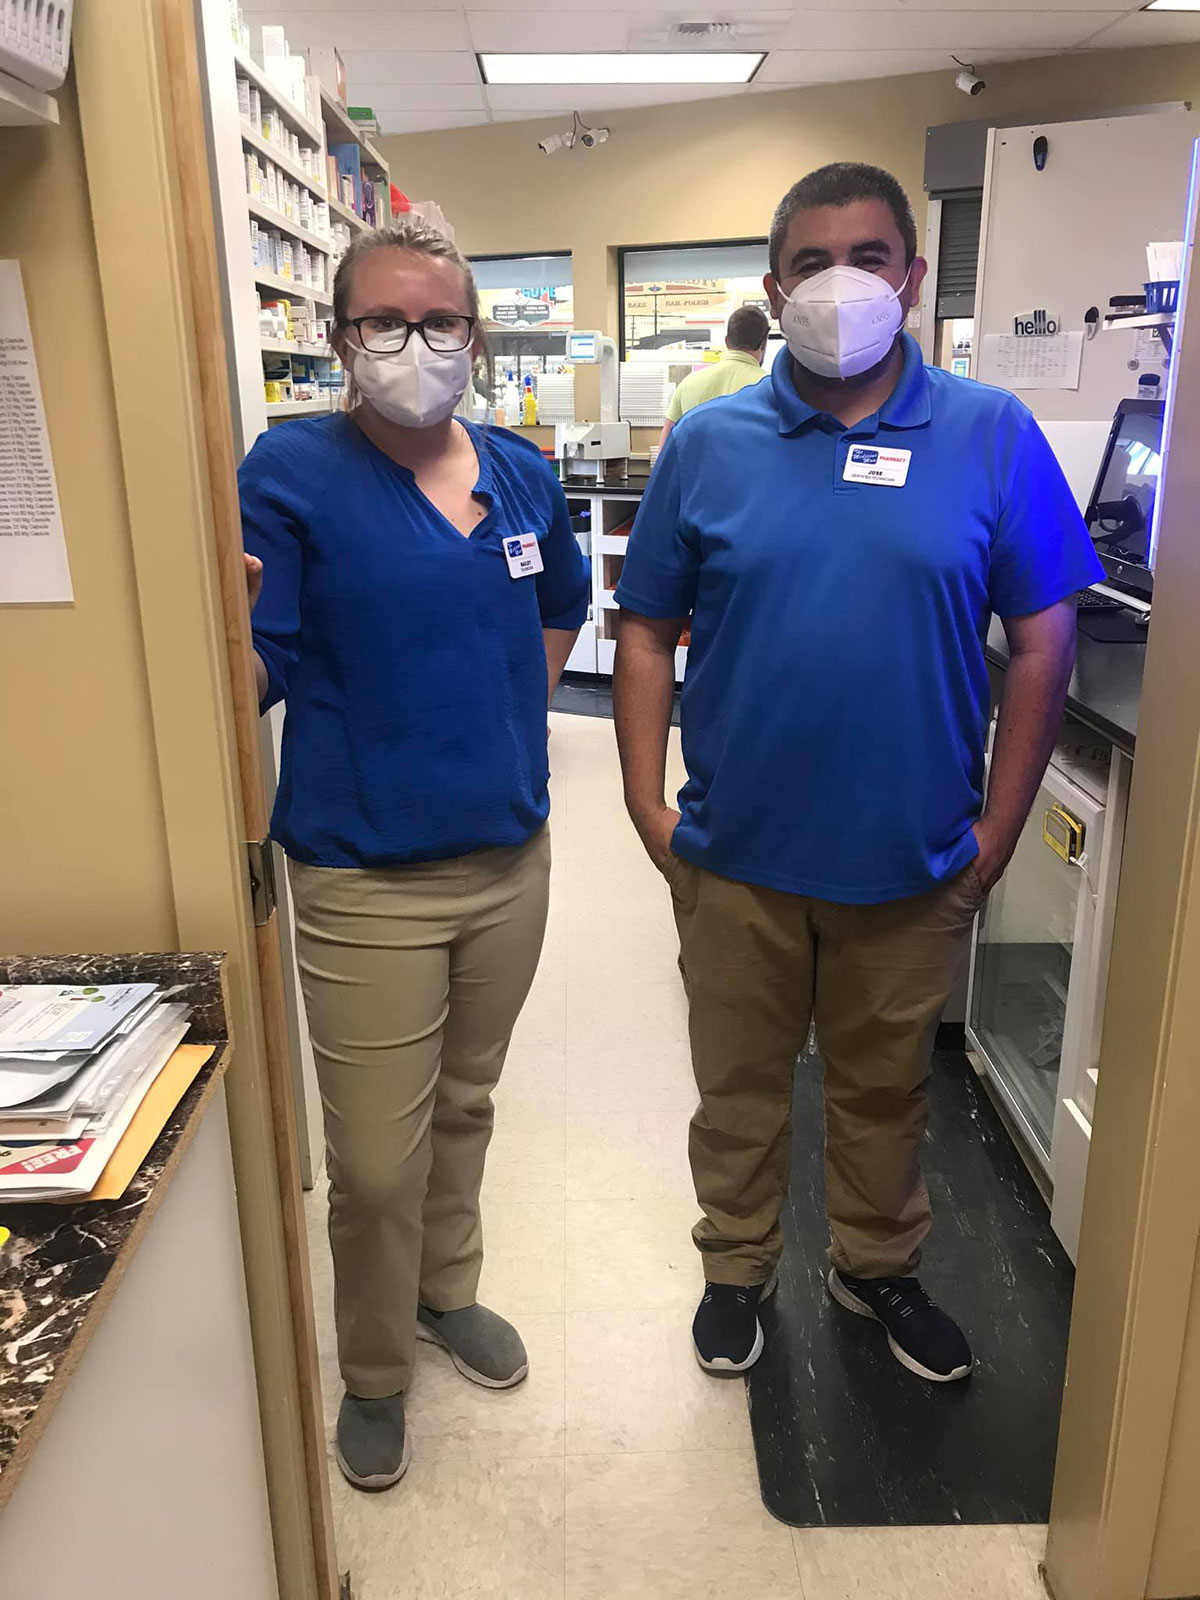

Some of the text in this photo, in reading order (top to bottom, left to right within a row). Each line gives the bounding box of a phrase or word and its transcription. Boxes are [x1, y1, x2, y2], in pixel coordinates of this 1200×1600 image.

[793, 314, 810, 327] KN95
[872, 312, 889, 325] KN95
[20, 1144, 84, 1172] FREE!
